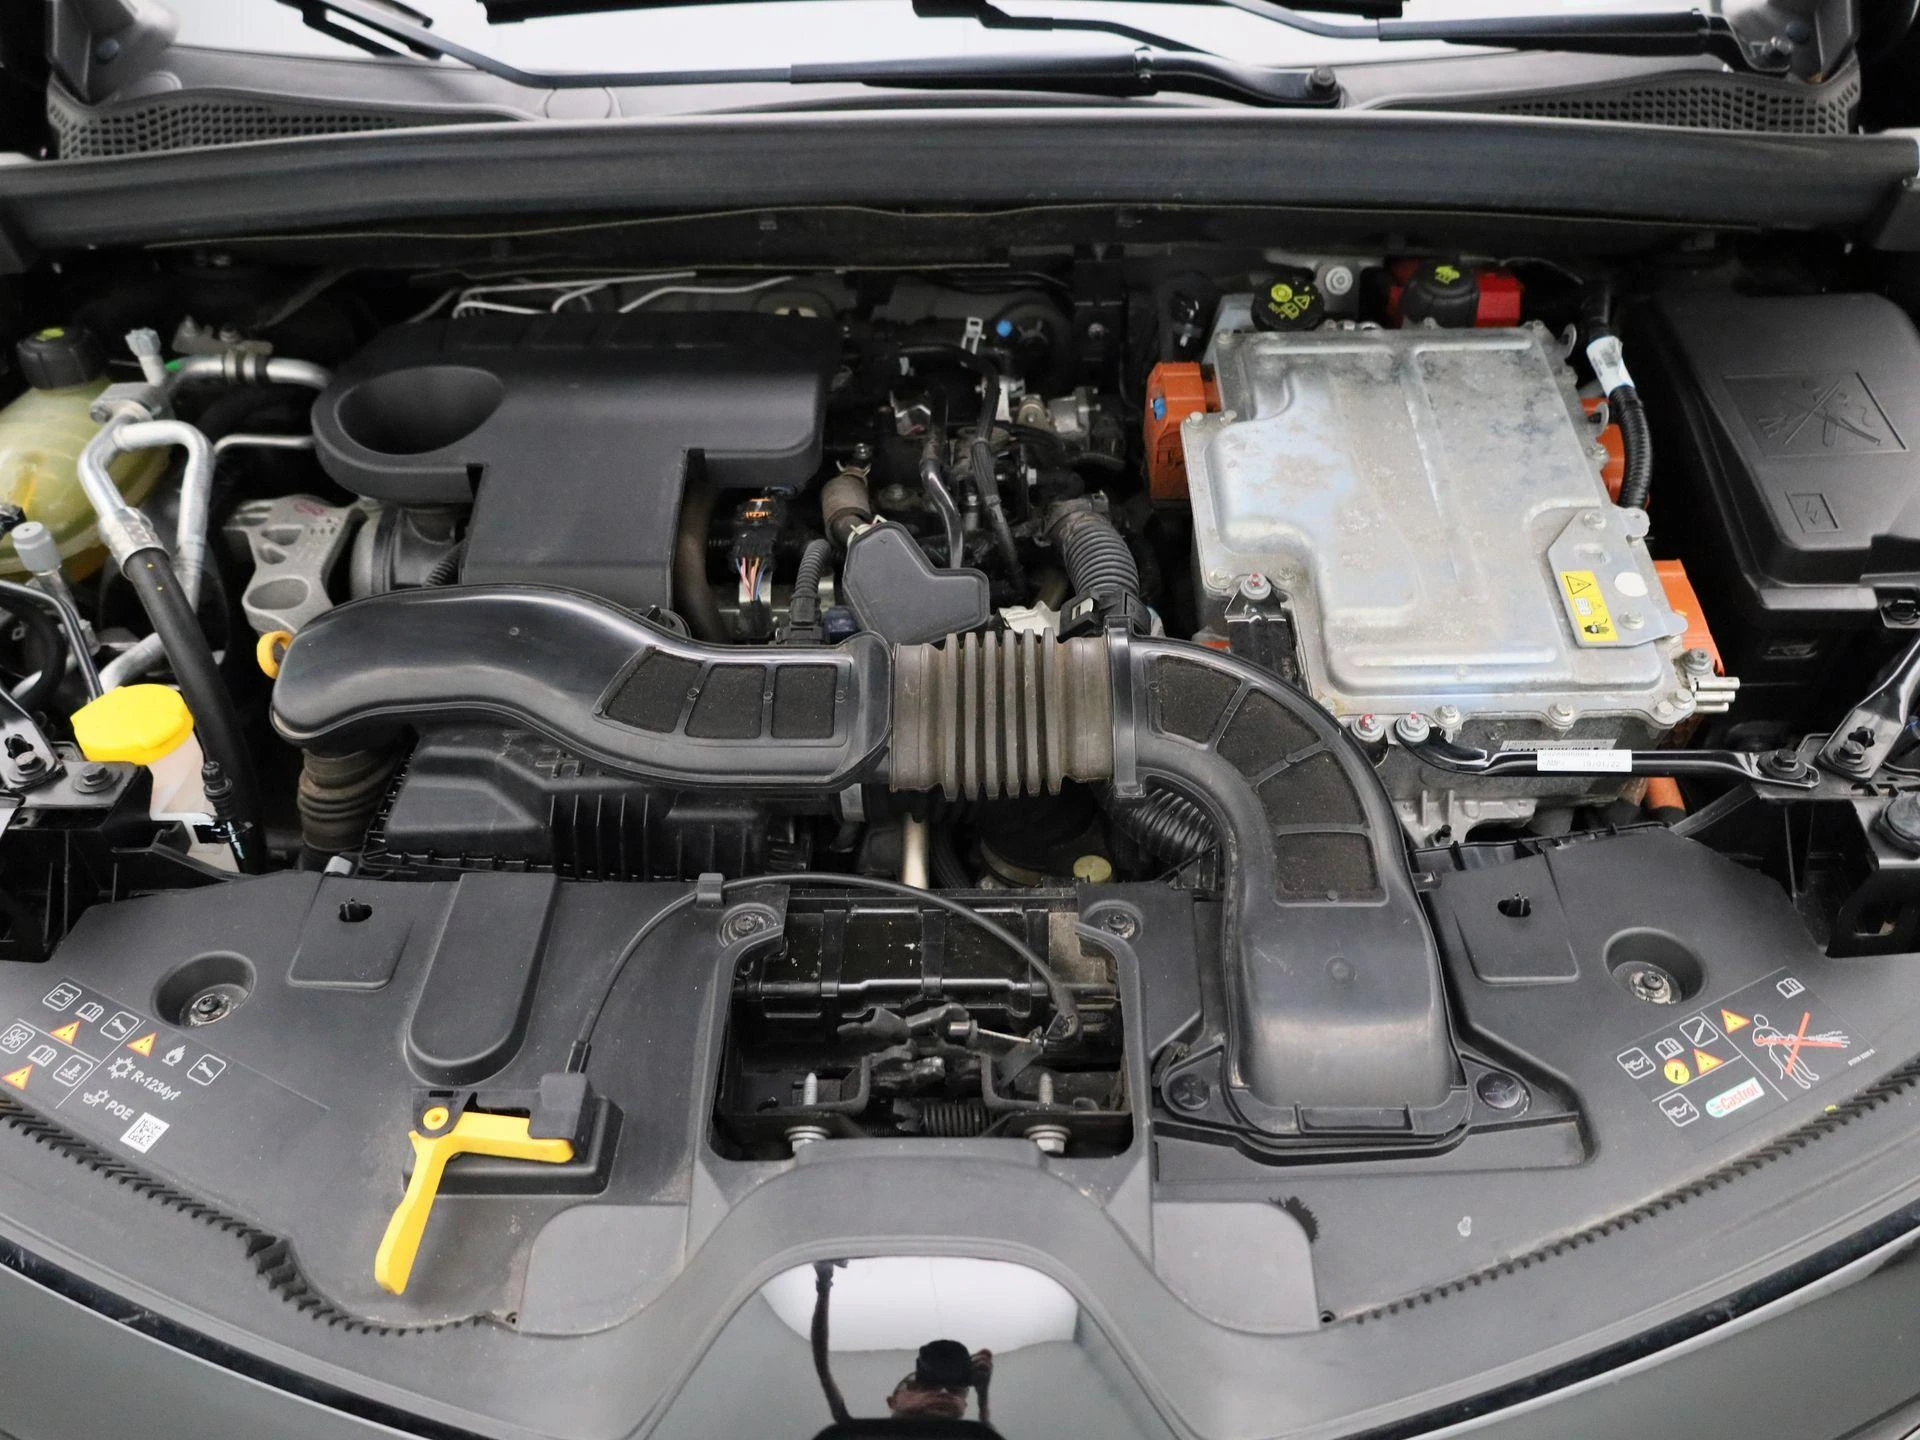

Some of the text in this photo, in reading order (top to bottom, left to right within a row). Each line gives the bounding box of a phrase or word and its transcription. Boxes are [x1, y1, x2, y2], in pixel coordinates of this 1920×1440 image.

[130, 1070, 182, 1101] R-1234yf
[1720, 1083, 1760, 1110] Castrol
[104, 1100, 135, 1121] POE
